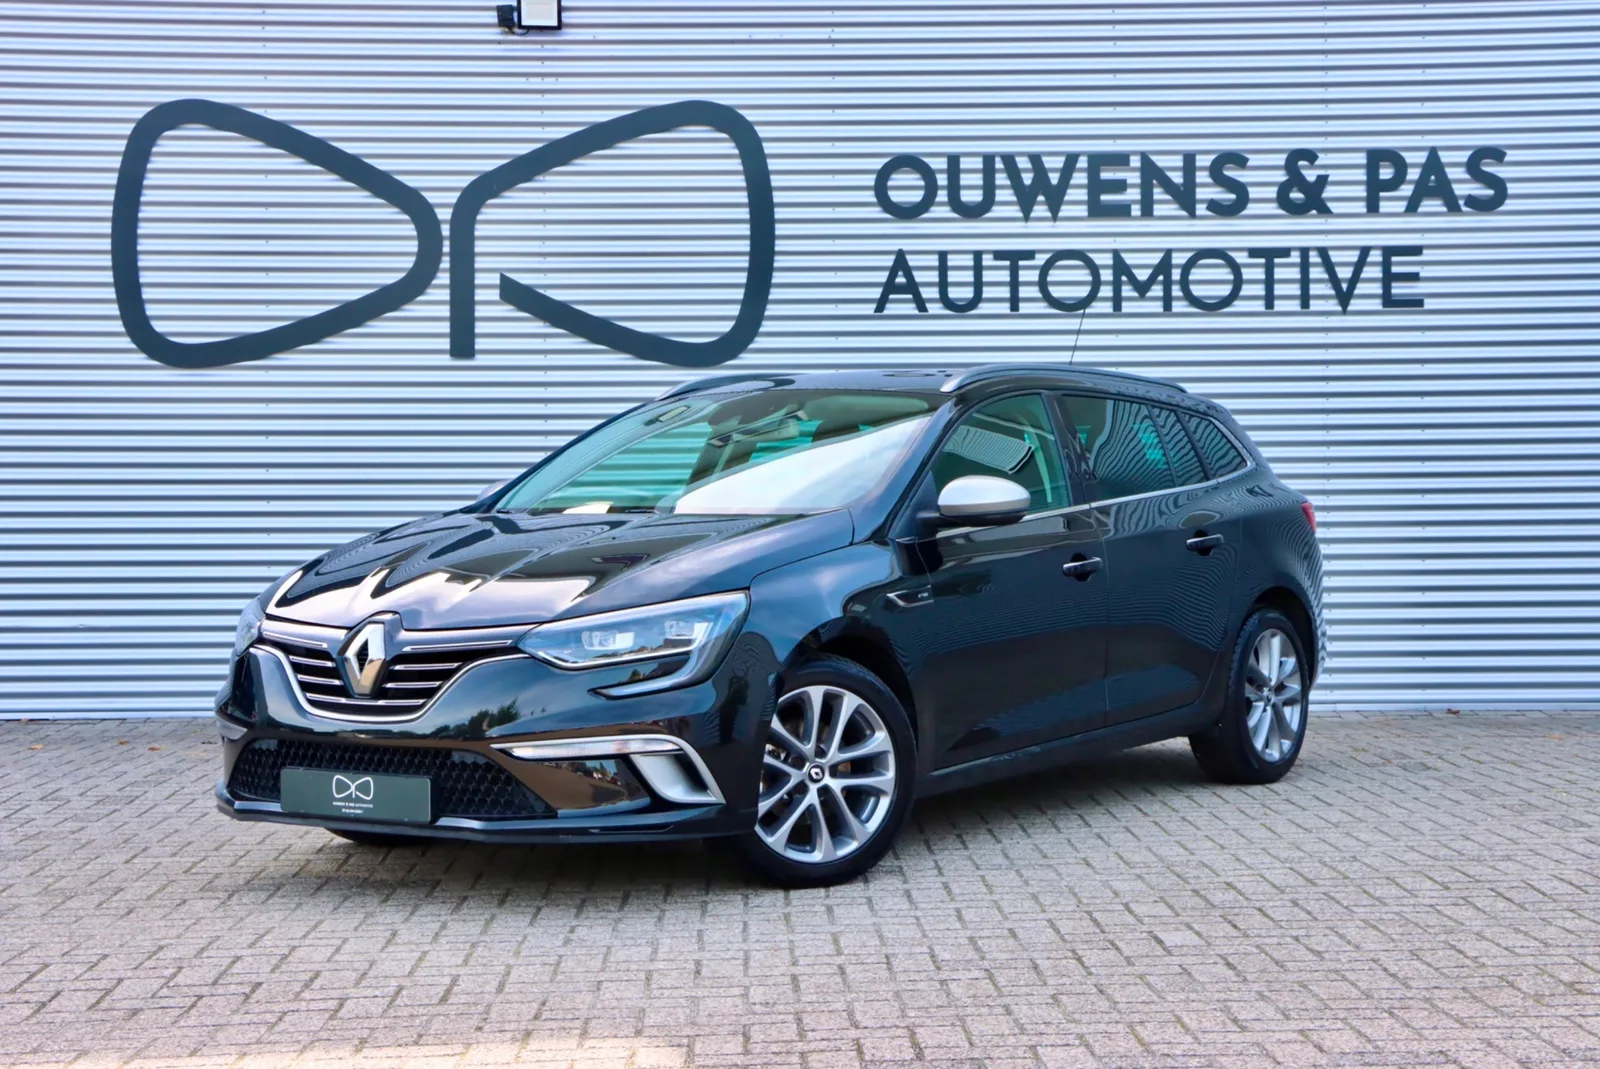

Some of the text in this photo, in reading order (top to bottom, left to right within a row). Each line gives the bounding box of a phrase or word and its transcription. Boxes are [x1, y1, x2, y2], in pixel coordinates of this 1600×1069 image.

[874, 147, 1508, 222] OUWENS & PAS
[874, 247, 1425, 315] AUTOMOTIVE
